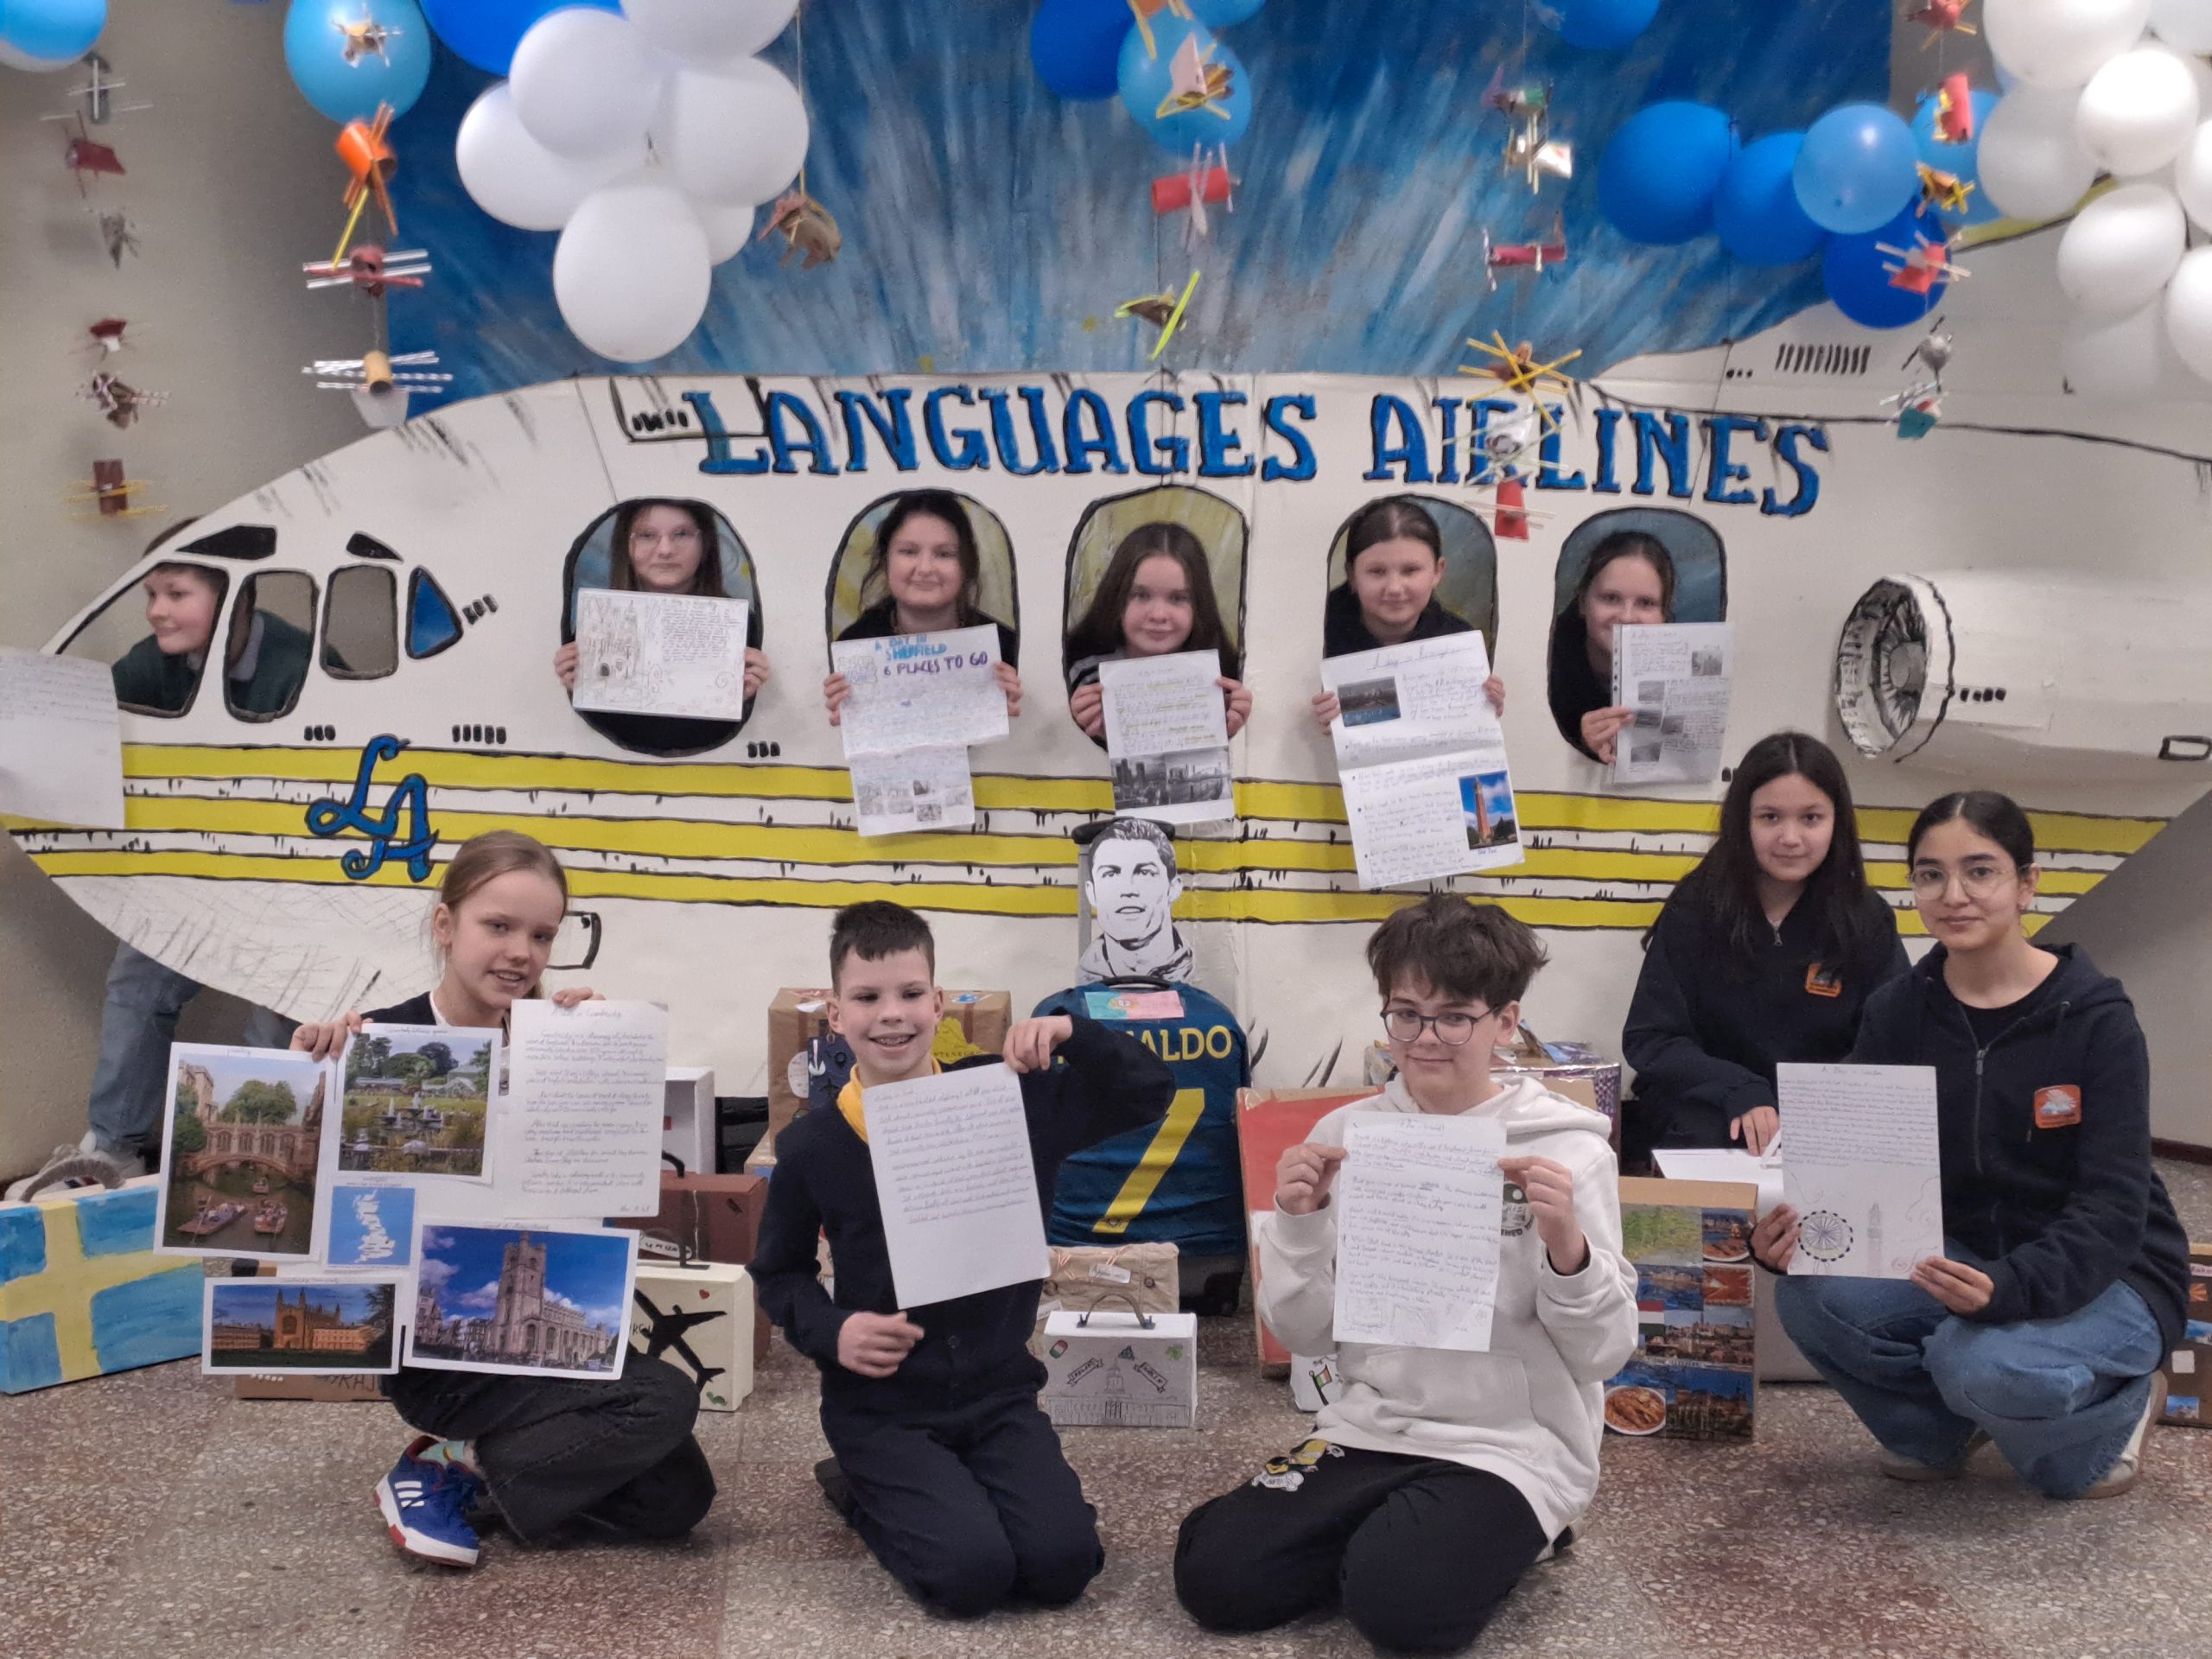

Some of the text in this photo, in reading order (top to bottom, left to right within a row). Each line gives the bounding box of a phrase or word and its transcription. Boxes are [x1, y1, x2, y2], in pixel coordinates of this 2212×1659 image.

[682, 383, 1317, 478] LANGUAGES
[897, 659, 940, 675] PLACES
[946, 656, 963, 669] TO
[969, 651, 988, 666] GO
[1057, 1026, 1233, 1065] ALDO
[1091, 1089, 1205, 1233] 7
